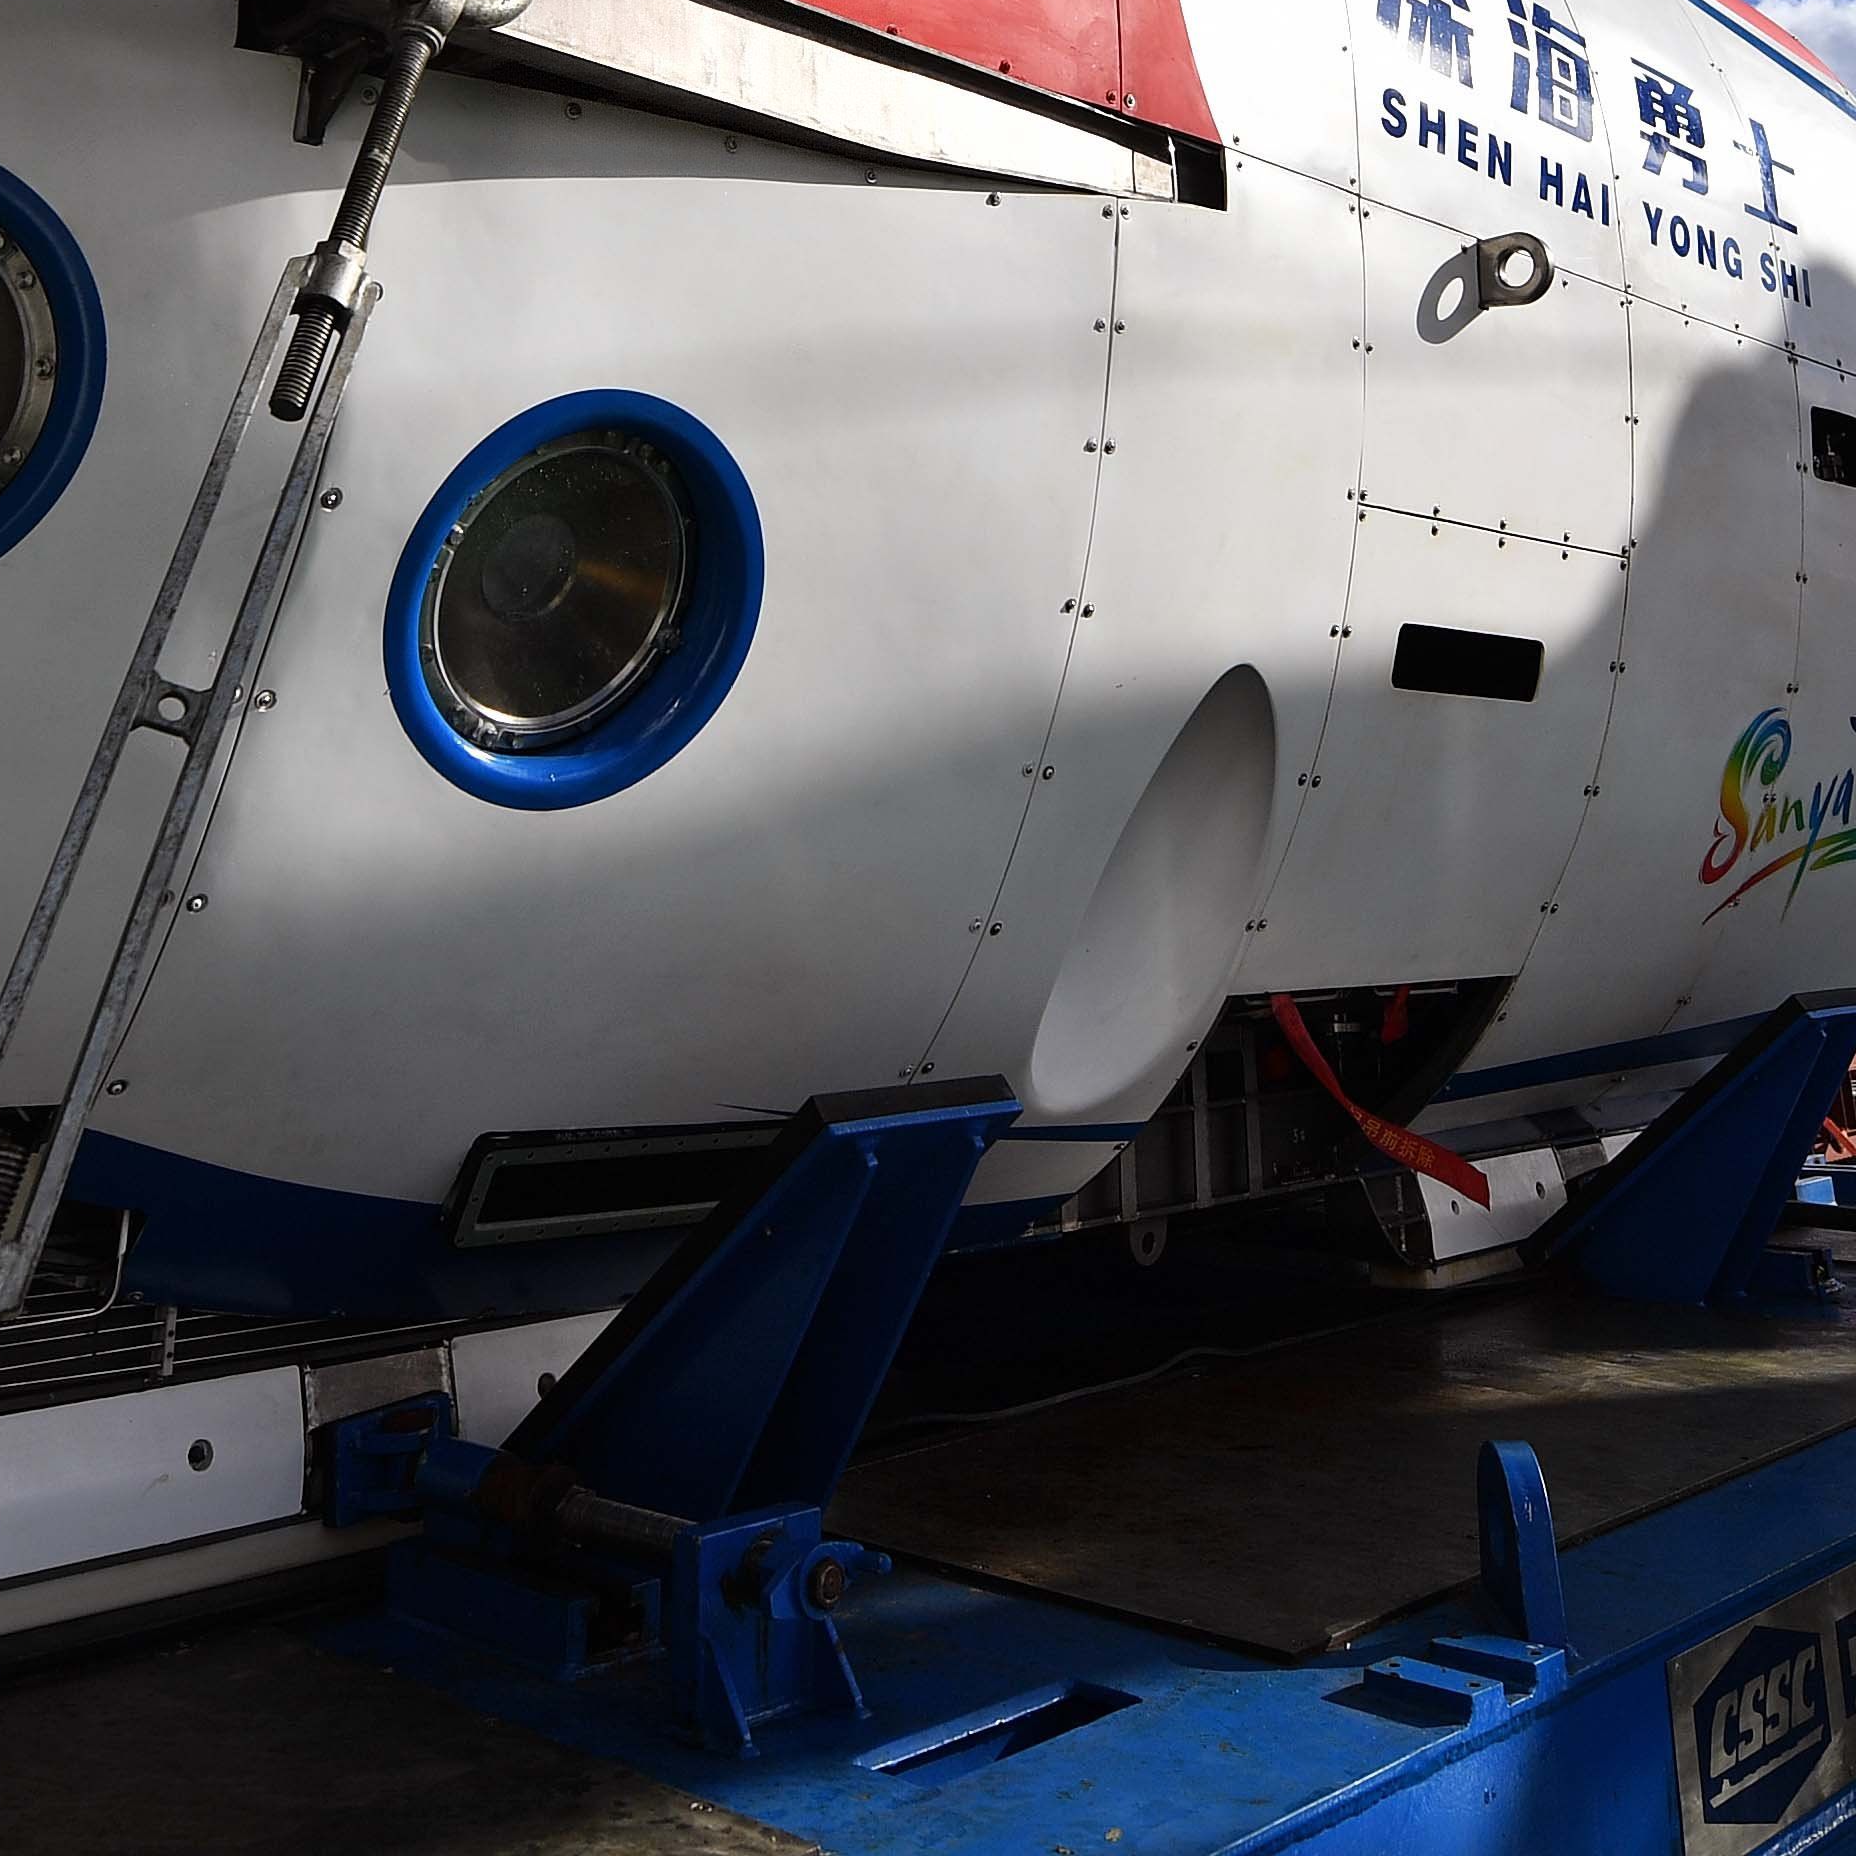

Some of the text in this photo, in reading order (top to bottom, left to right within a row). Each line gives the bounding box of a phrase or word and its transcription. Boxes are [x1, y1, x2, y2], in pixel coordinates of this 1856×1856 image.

[1381, 87, 1812, 308] SHEN HAI YONG SHI
[1698, 706, 1854, 925] Sanya
[1710, 1644, 1817, 1779] CSSC
